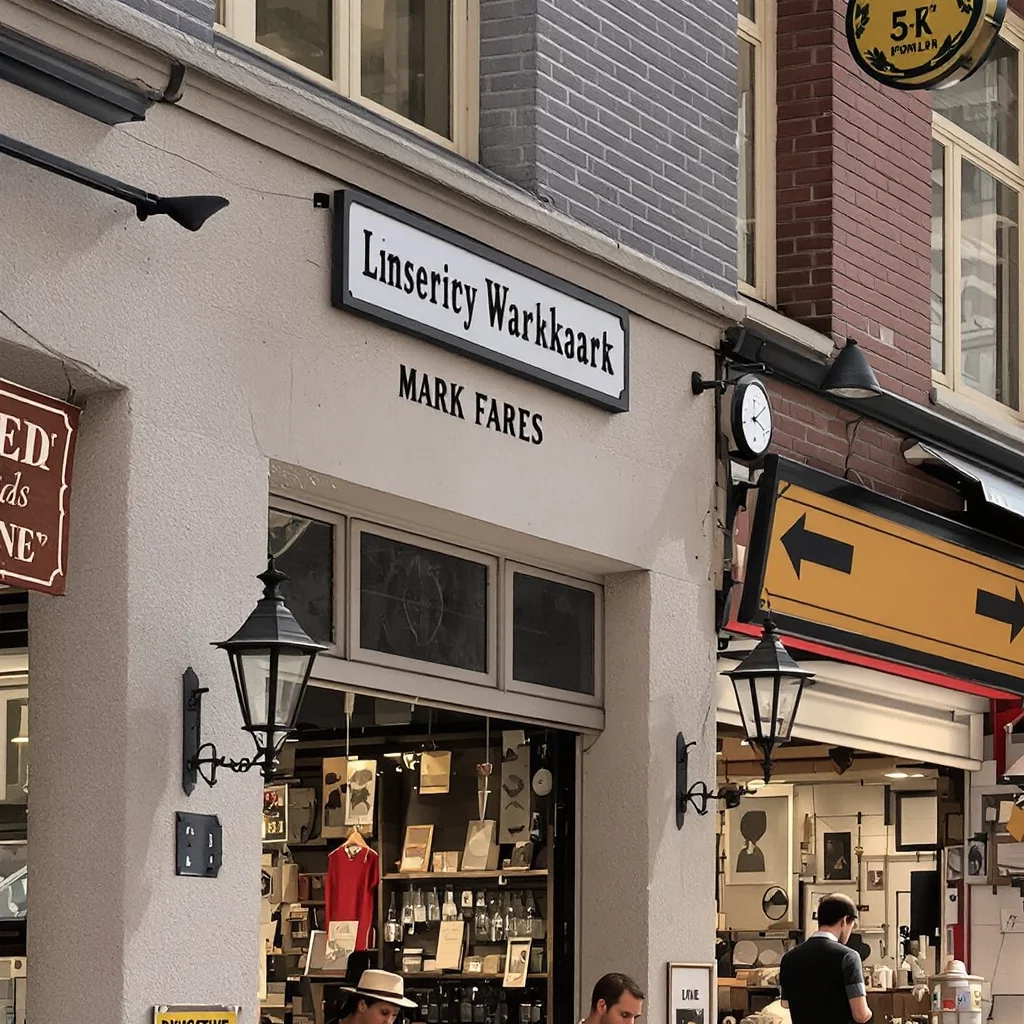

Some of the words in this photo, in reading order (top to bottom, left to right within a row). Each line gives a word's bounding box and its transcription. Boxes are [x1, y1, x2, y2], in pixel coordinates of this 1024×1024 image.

[484, 277, 615, 376] Warkkaark
[398, 363, 466, 420] MARK
[474, 391, 544, 445] FARES
